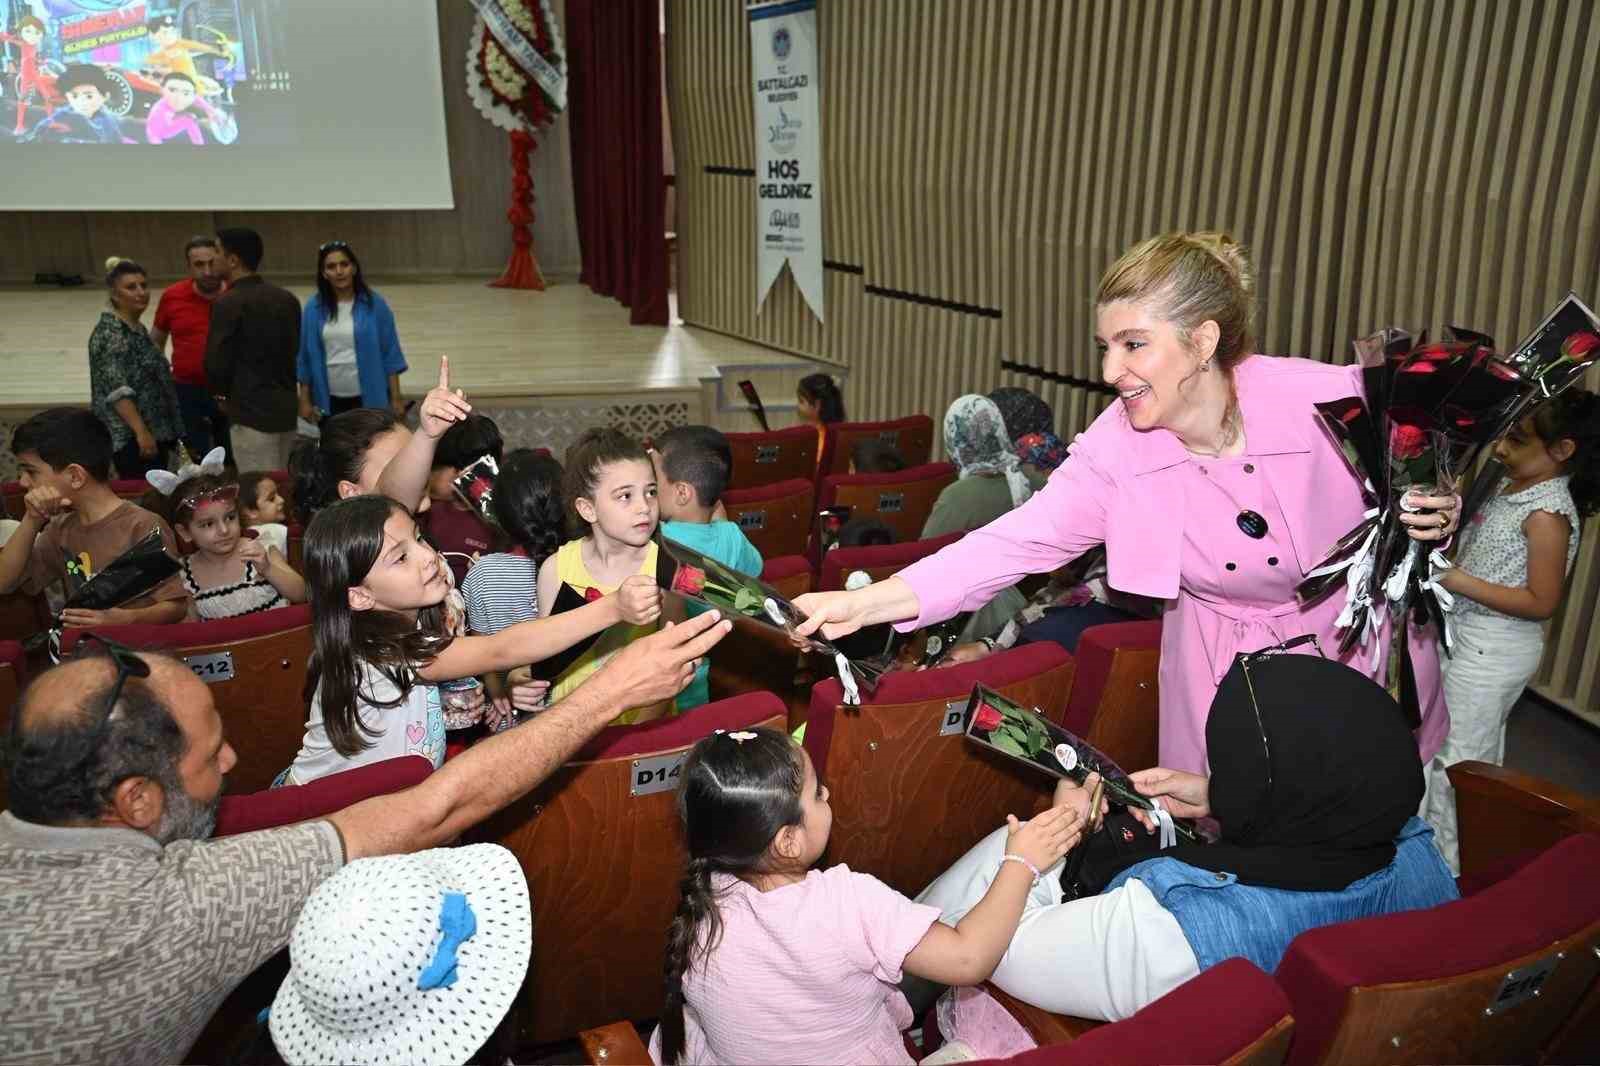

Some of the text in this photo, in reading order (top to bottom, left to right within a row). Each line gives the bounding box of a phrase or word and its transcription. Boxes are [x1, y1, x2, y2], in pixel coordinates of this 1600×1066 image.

[767, 159, 800, 181] HOŞ
[192, 660, 229, 675] C12
[637, 764, 681, 785] D14
